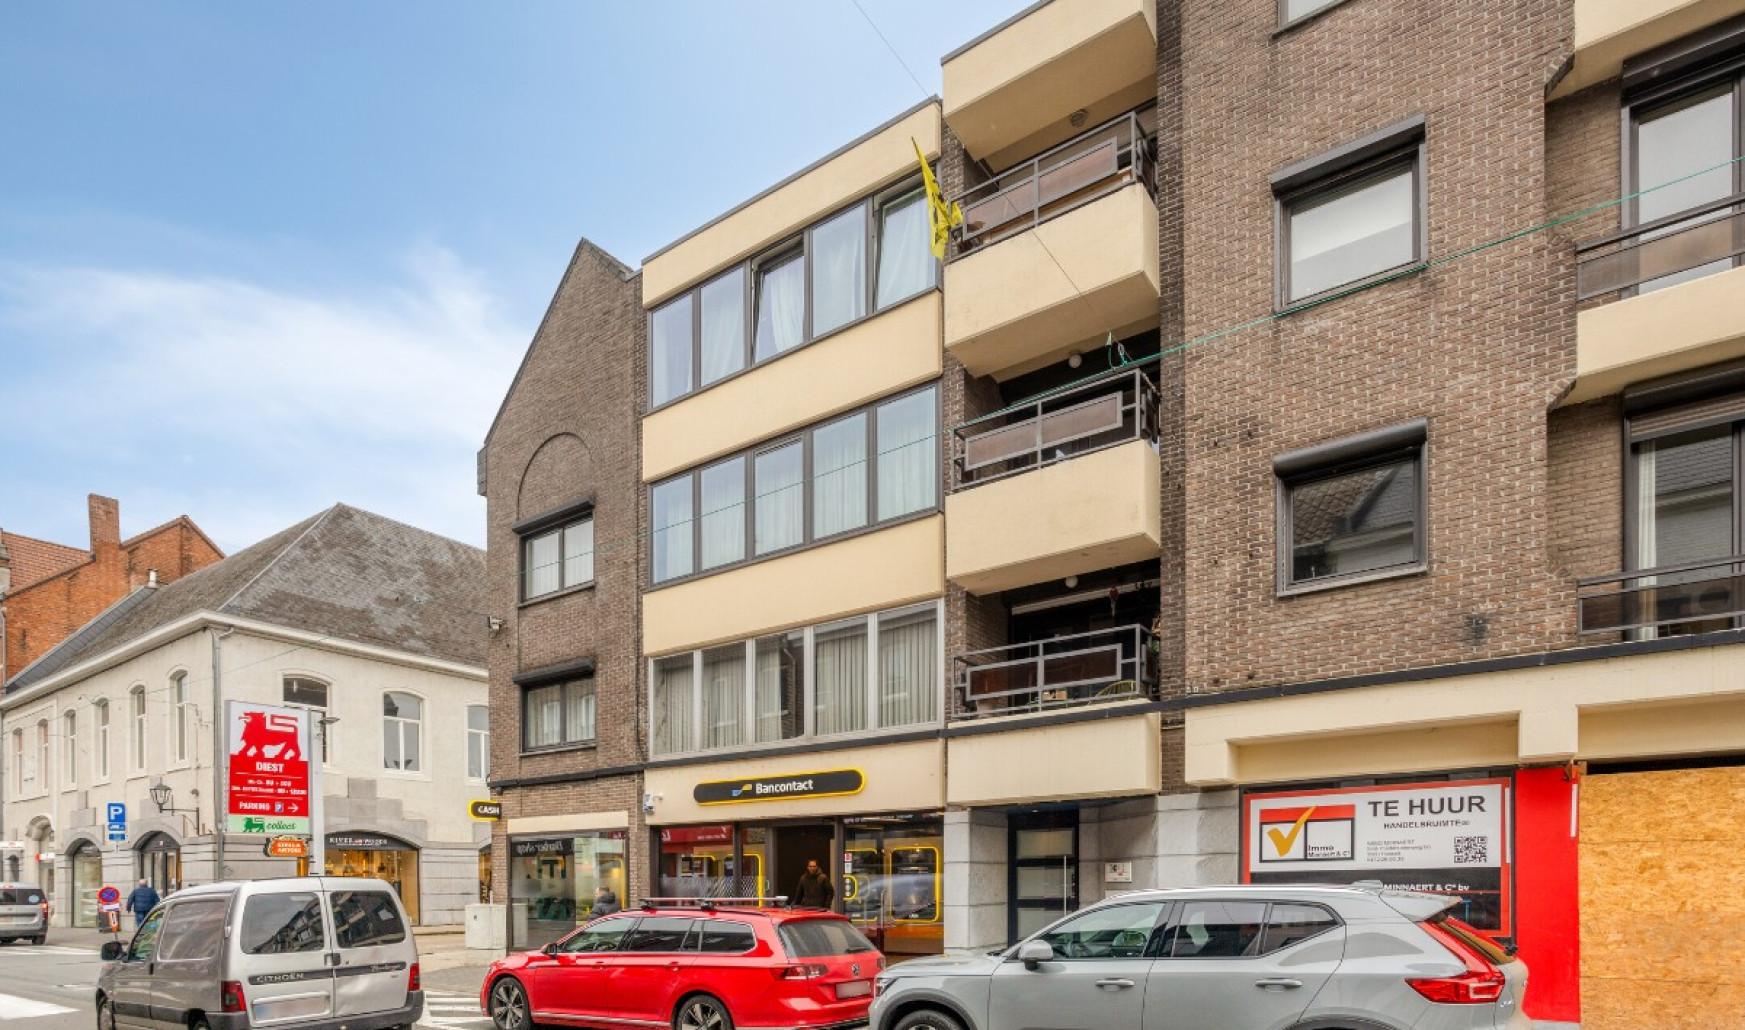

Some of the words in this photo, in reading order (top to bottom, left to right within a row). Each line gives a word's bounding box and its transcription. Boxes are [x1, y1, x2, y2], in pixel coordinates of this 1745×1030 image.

[255, 761, 285, 772] DIEST
[755, 779, 814, 795] Bancontact
[239, 801, 270, 811] PARKING
[477, 804, 500, 815] CASH
[1368, 801, 1400, 817] TE
[1408, 795, 1486, 815] HUUR
[110, 805, 123, 820] P
[266, 820, 296, 830] collect
[1383, 883, 1435, 892] MINNAERT
[1436, 883, 1444, 891] &
